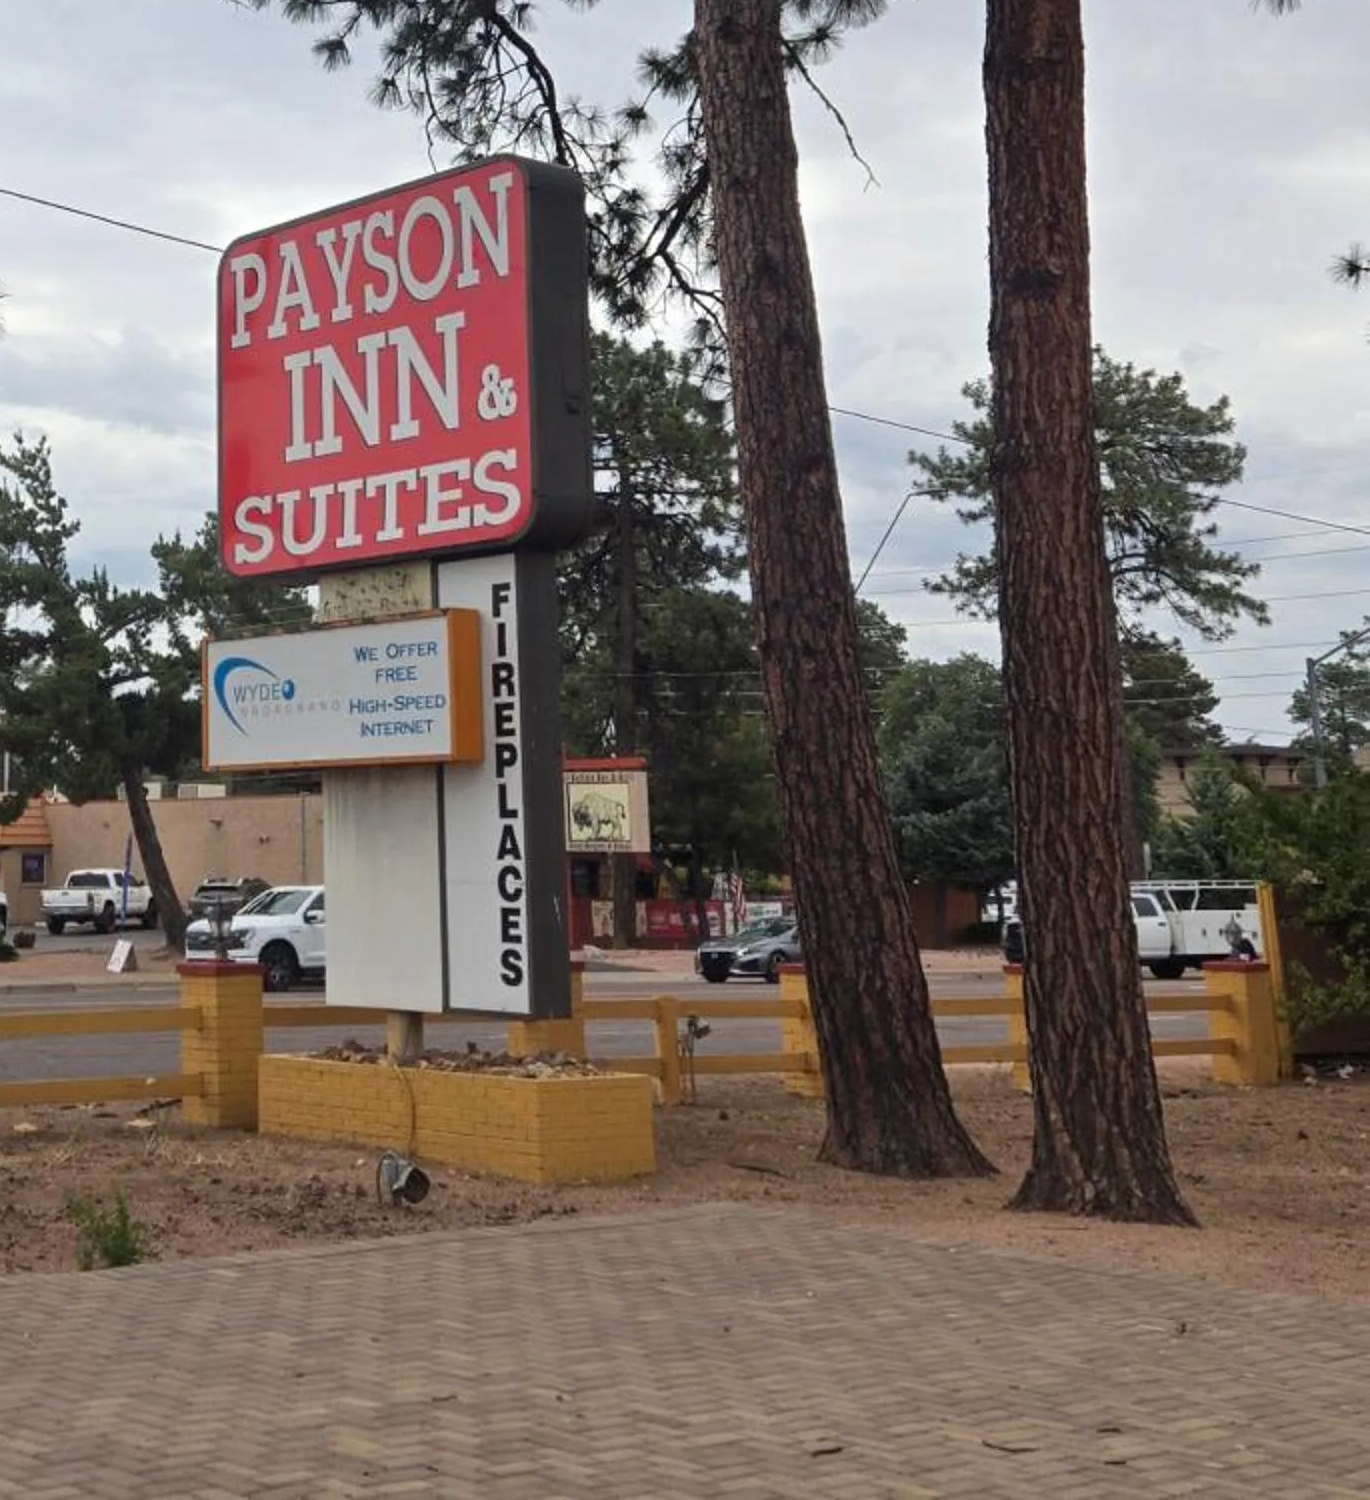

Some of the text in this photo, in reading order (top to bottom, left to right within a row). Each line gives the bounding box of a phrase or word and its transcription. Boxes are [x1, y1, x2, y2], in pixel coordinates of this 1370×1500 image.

[230, 172, 513, 349] PAYSON
[284, 310, 517, 462] INN &
[234, 448, 521, 564] SUITES
[353, 641, 438, 662] WE OFFER
[375, 666, 418, 684] FREE
[349, 693, 446, 714] HIGH-SPEED
[360, 719, 435, 738] INTERNET
[491, 583, 523, 987] FIREPLACES
